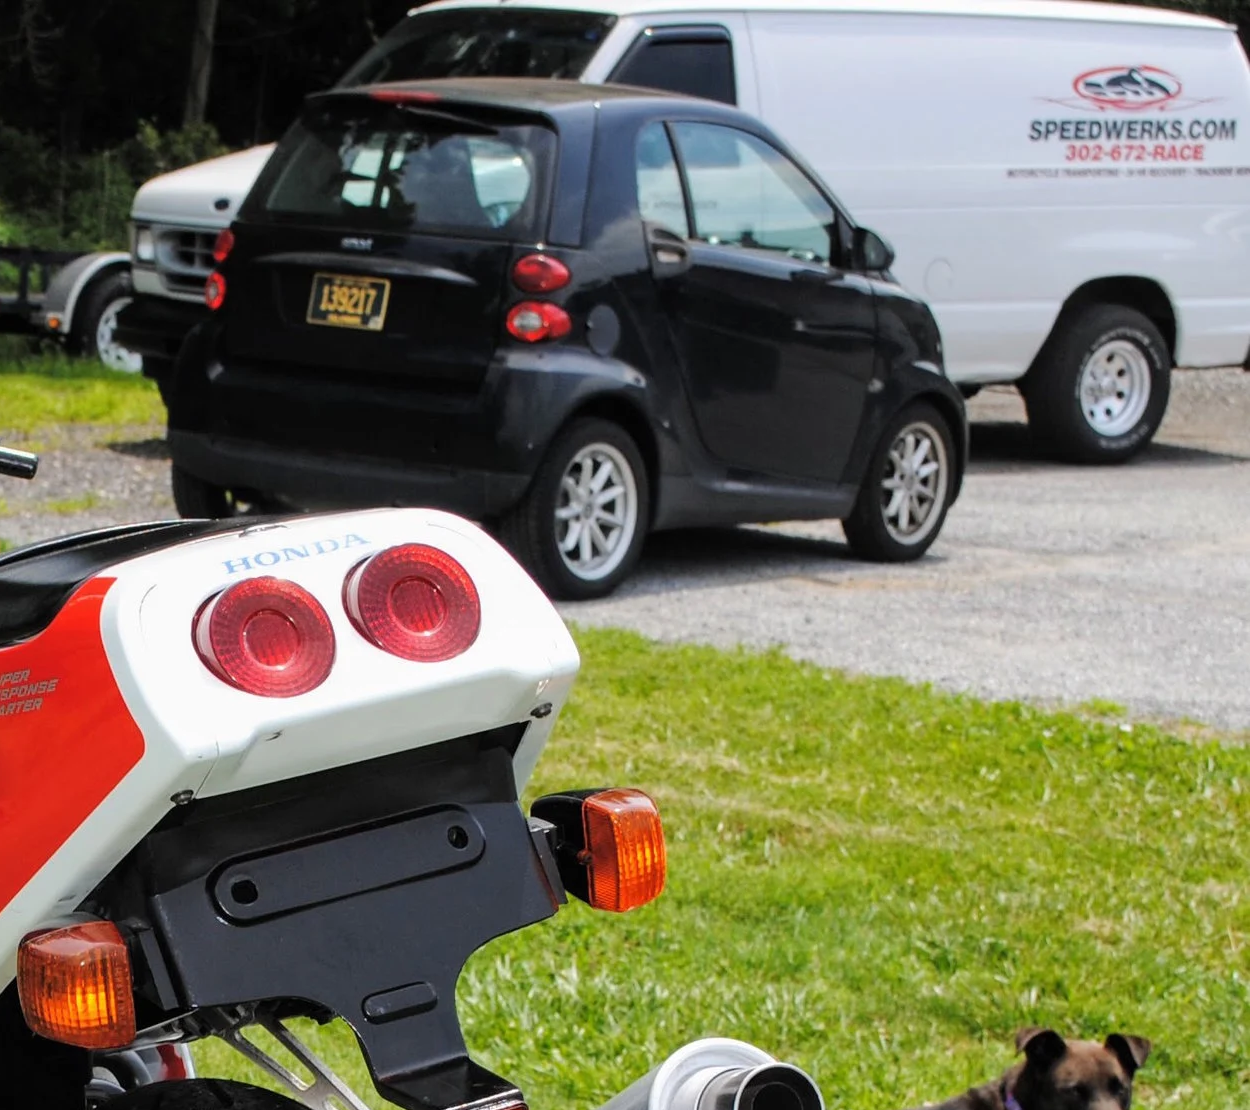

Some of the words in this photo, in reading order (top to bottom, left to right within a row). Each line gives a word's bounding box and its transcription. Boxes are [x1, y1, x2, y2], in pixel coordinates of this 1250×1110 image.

[1029, 119, 1237, 142] SPEEDWERKS.COM
[1065, 144, 1205, 162] 302-672-RACE
[223, 534, 370, 574] HONDA
